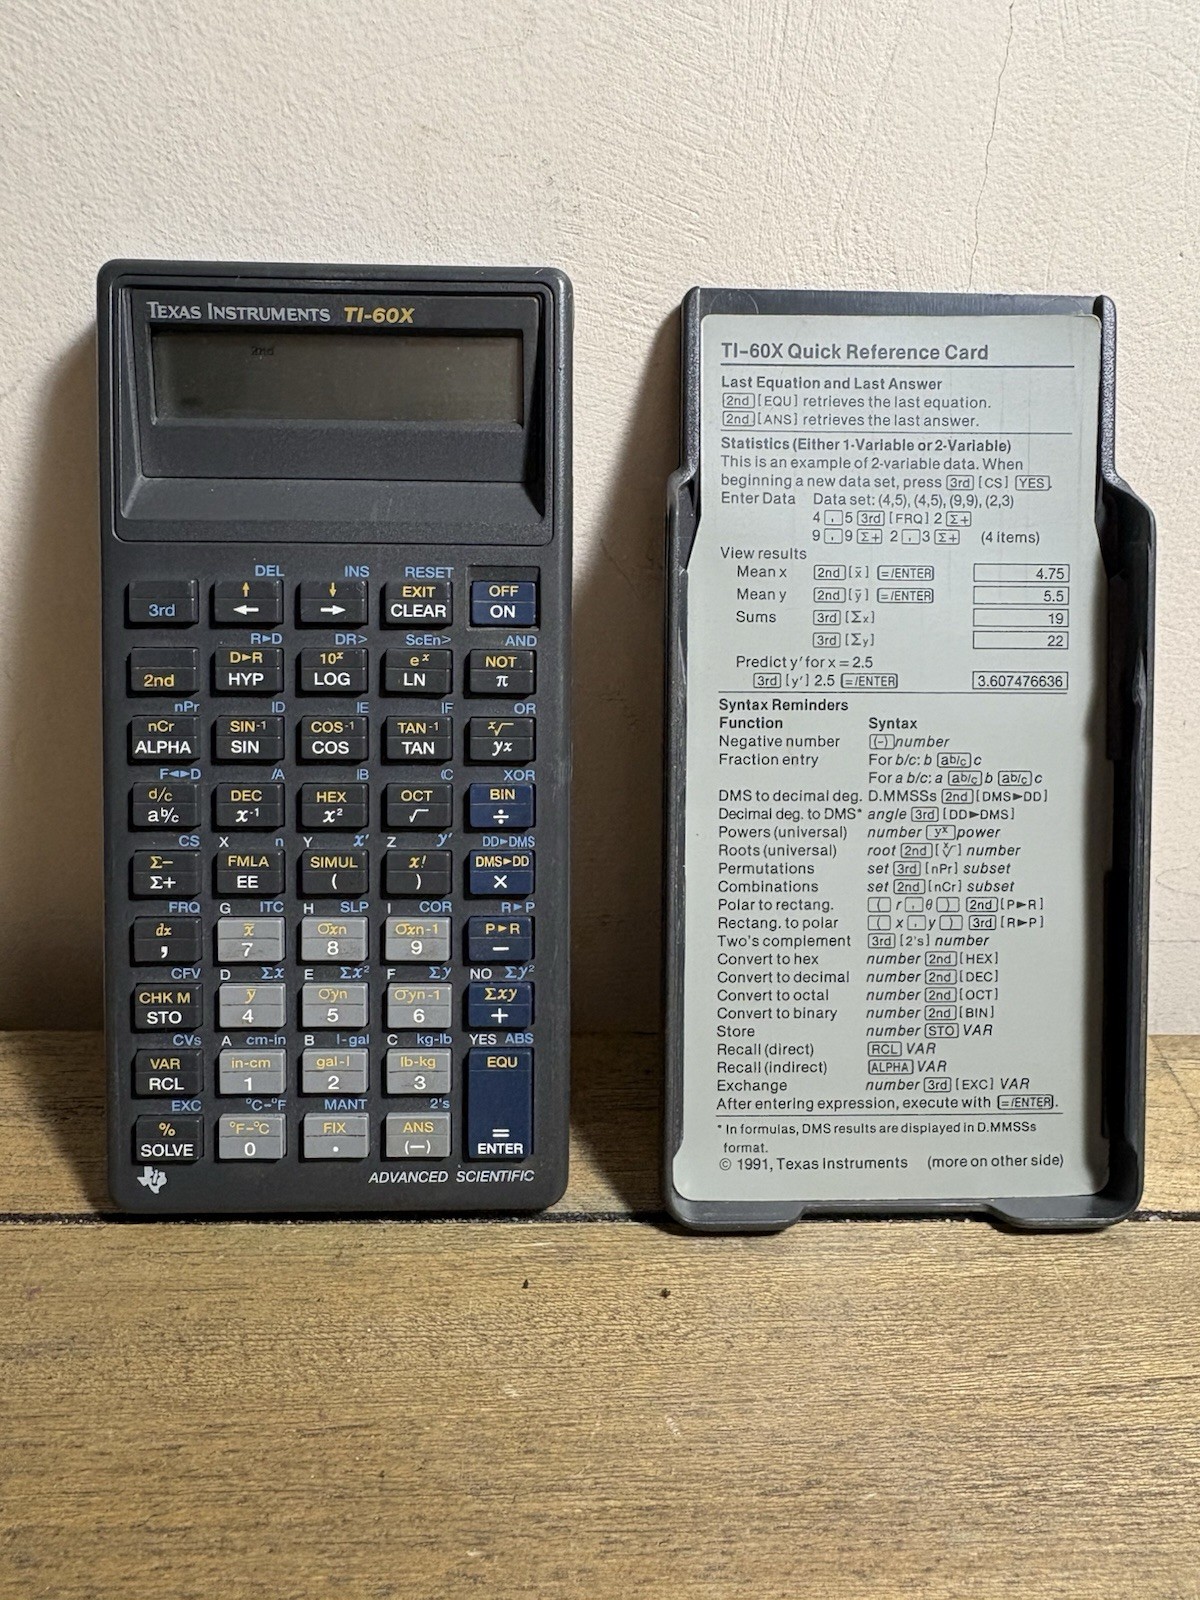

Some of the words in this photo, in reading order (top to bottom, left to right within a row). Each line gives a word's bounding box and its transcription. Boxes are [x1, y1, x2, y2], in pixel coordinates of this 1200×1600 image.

[344, 307, 415, 323] TI-60X
[722, 343, 783, 358] TI-60X
[788, 343, 841, 359] Quick
[847, 344, 939, 359] Reference
[945, 345, 988, 359] Card
[722, 376, 752, 388] Last
[757, 376, 820, 391] Equation
[824, 378, 850, 389] and
[855, 378, 884, 389] Last
[888, 378, 942, 389] Answer
[804, 396, 864, 407] retrieves
[869, 396, 890, 407] the
[895, 397, 920, 408] last
[924, 397, 990, 410] equation.
[722, 437, 789, 449] Statistics
[793, 438, 839, 452] (Either
[844, 439, 914, 451] 1-Variable
[918, 442, 932, 451] or
[935, 440, 1011, 454] 2-Variable)
[721, 455, 751, 467] This
[756, 456, 766, 467] is
[770, 459, 786, 467] an
[791, 457, 850, 470] example
[854, 457, 868, 469] of
[872, 457, 940, 469] 2-variable
[944, 458, 978, 470] data.
[983, 458, 1023, 470] When
[722, 474, 791, 489] beginning
[796, 478, 803, 486] a
[808, 478, 835, 487] new
[839, 476, 870, 487] data
[874, 477, 899, 489] set,
[904, 479, 941, 490] press
[722, 491, 759, 504] Enter
[763, 492, 795, 504] Data
[255, 565, 284, 576] DEL
[345, 566, 369, 577] INS
[405, 567, 454, 578] RESET
[1036, 568, 1064, 579] 4.75
[403, 586, 435, 597] EXIT
[489, 586, 518, 597] OFF
[149, 604, 175, 616] 3rd
[391, 604, 446, 617] CLEAR
[490, 605, 515, 618] ON
[737, 611, 776, 622] Sums
[1049, 613, 1063, 624] 19
[336, 634, 367, 645] DR>
[505, 635, 537, 646] AND
[486, 656, 517, 668] NOT
[144, 674, 174, 687] 2nd
[229, 673, 263, 685] HYP
[315, 672, 350, 685] LOG
[404, 673, 425, 686] LN
[978, 675, 1062, 687] 3.607476636
[175, 701, 199, 712] nPr
[514, 703, 535, 714] OR
[720, 699, 768, 713] Syntax
[773, 699, 848, 710] Reminders
[149, 720, 174, 732] nCr
[720, 717, 782, 728] Function
[869, 717, 917, 731] Syntax
[135, 741, 191, 753] ALPHA
[231, 740, 259, 753] SIN
[312, 741, 349, 754] COS
[402, 742, 434, 754] TAN
[720, 735, 782, 749] Negative
[787, 736, 840, 747] number
[720, 754, 778, 765] Fraction
[783, 755, 818, 768] entry
[504, 770, 535, 781] XOR
[231, 790, 262, 801] DEC
[317, 792, 346, 802] HEX
[401, 790, 433, 801] OCT
[490, 789, 515, 799] BIN
[719, 790, 752, 801] DMS
[756, 791, 769, 801] to
[773, 790, 828, 801] decimal
[833, 790, 862, 804] deg.
[719, 826, 770, 837] Powers
[774, 826, 847, 840] (universal)
[179, 835, 199, 847] CS
[229, 856, 269, 867] FMLA
[311, 857, 357, 868] SIMUL
[719, 863, 814, 874] Permutations
[237, 876, 258, 888] EE
[718, 881, 818, 892] Combinations
[169, 902, 200, 913] FRQ
[260, 901, 283, 912] ITC
[341, 901, 369, 913] SLP
[420, 901, 452, 912] COR
[242, 943, 253, 956] 7
[328, 941, 338, 955] 8
[411, 941, 422, 954] 9
[718, 953, 772, 965] Convert
[777, 954, 790, 964] to
[795, 953, 818, 964] hex
[171, 968, 200, 979] CFV
[470, 968, 492, 979] NO
[139, 992, 172, 1003] CHK
[178, 992, 190, 1003] M
[147, 1011, 181, 1024] STO
[243, 1009, 253, 1022] 4
[328, 1009, 338, 1022] 5
[414, 1009, 424, 1022] 6
[173, 1034, 201, 1046] CVs
[246, 1034, 286, 1045] cm-in
[417, 1034, 452, 1047] kg-lb
[470, 1034, 496, 1045] YES
[505, 1033, 533, 1044] ABS
[150, 1058, 180, 1069] VAR
[232, 1058, 270, 1068] in-cm
[401, 1056, 435, 1069] lb-kg
[488, 1057, 517, 1067] EQU
[150, 1078, 184, 1090] RCL
[244, 1078, 251, 1091] 1
[328, 1076, 339, 1089] 2
[414, 1076, 426, 1089] 3
[718, 1080, 787, 1094] Exchange
[172, 1100, 201, 1111] EXC
[325, 1099, 367, 1110] MANT
[717, 1098, 751, 1109] After
[755, 1098, 813, 1112] entering
[818, 1097, 899, 1111] expression,
[903, 1098, 958, 1108] execute
[962, 1096, 990, 1107] with
[324, 1123, 346, 1133] FIX
[403, 1122, 433, 1132] ANS
[727, 1125, 736, 1134] In
[741, 1124, 798, 1135] formulas,
[803, 1124, 831, 1133] DMS
[834, 1124, 876, 1133] results
[879, 1125, 898, 1133] are
[901, 1123, 960, 1135] displayed
[964, 1123, 974, 1132] in
[978, 1122, 1036, 1132] D.MMSSs
[141, 1144, 193, 1157] SOLVE
[245, 1142, 255, 1156] 0
[478, 1143, 523, 1154] ENTER
[724, 1143, 768, 1153] format.
[738, 1158, 772, 1172] 1991,
[777, 1158, 818, 1169] Texas
[823, 1158, 908, 1169] Instruments
[928, 1156, 967, 1170] (more
[971, 1158, 987, 1167] on
[991, 1155, 1027, 1166] other
[1031, 1154, 1063, 1167] side)
[369, 1171, 448, 1183] ADVANCED
[456, 1170, 534, 1182] SCIENTIFIC
